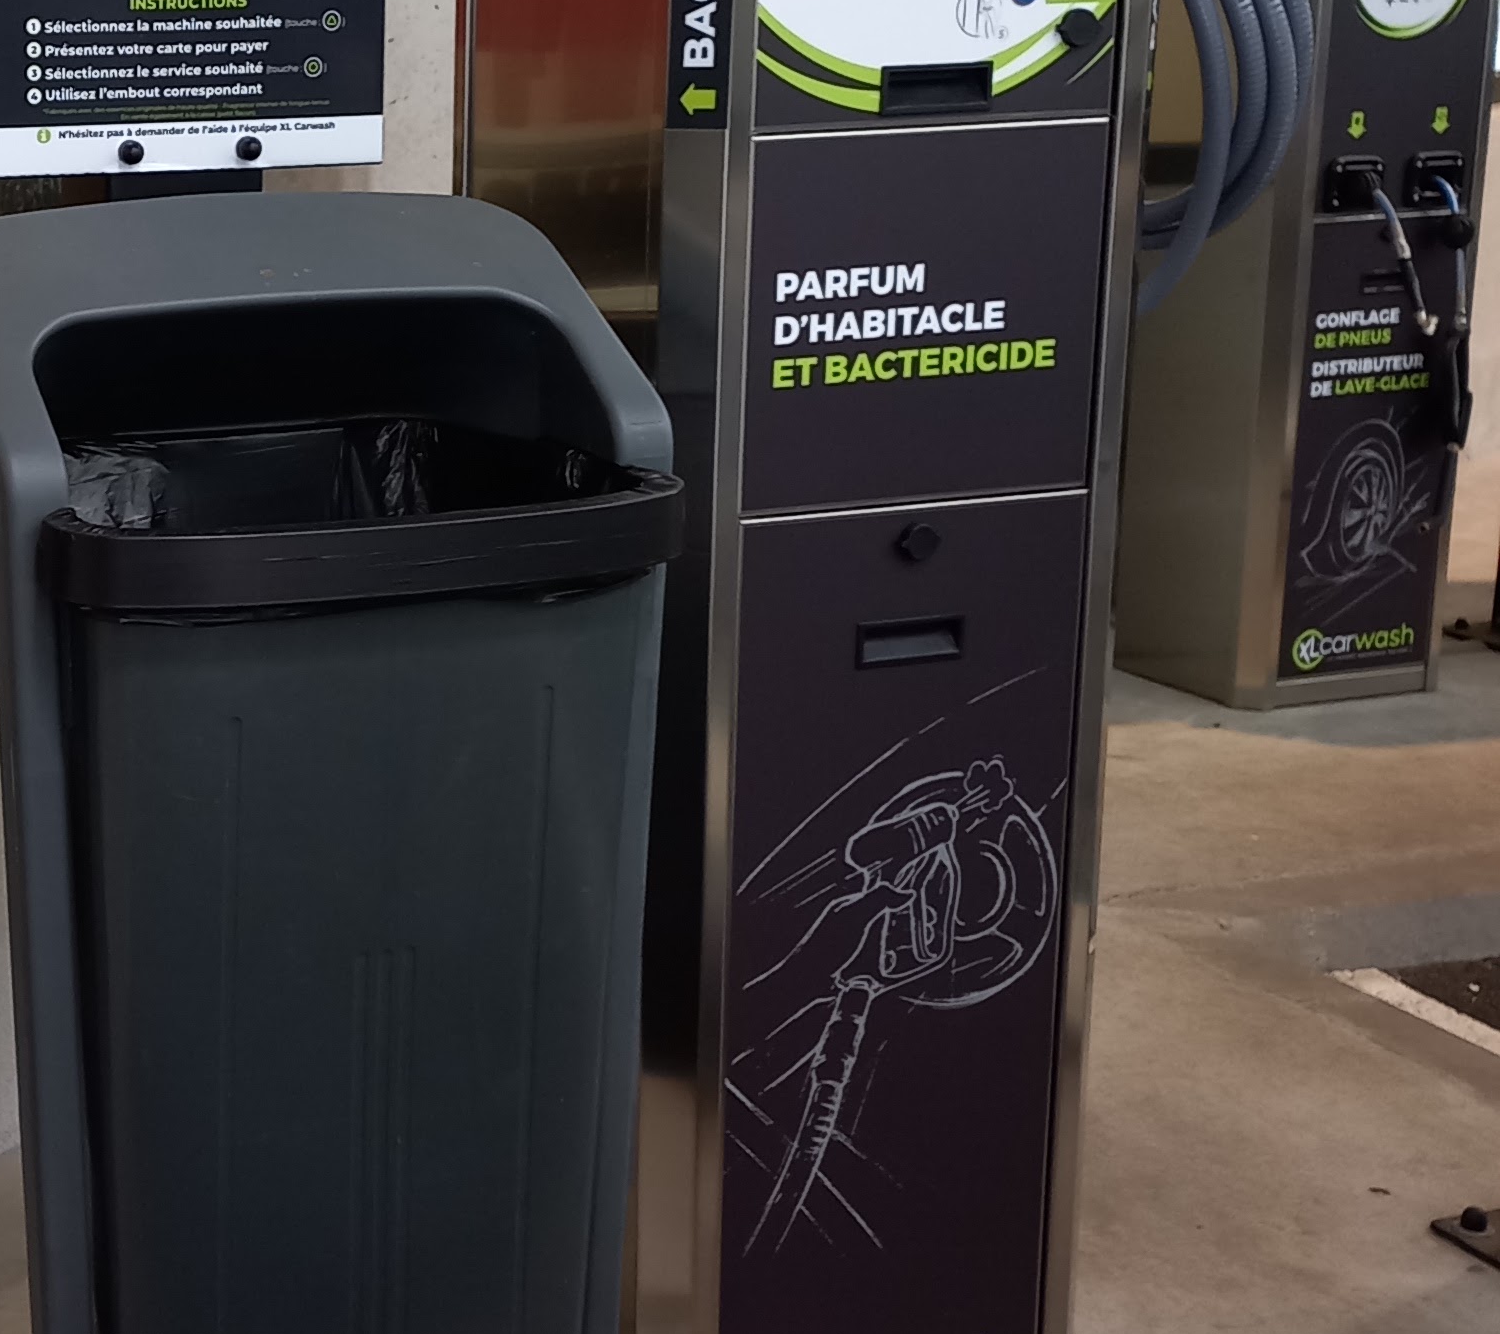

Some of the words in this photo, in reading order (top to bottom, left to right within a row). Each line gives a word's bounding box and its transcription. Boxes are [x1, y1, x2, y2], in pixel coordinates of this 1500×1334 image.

[44, 19, 135, 34] Sélectionnez
[136, 19, 150, 32] la
[152, 17, 212, 32] machine
[215, 15, 283, 30] souhaitée
[45, 43, 115, 57] Présentez
[117, 44, 154, 55] votre
[156, 43, 193, 54] carte
[195, 43, 228, 56] pour
[230, 41, 269, 55] payer
[44, 66, 135, 80] Sélectionnez
[137, 65, 150, 78] le
[152, 63, 202, 77] service
[204, 61, 264, 75] souhaité
[45, 87, 97, 102] Utilisez
[163, 83, 263, 99] correspondant
[106, 129, 124, 140] pas
[135, 127, 185, 137] demander
[188, 126, 200, 135] de
[280, 122, 292, 131] XL
[294, 122, 336, 131] Carwash
[776, 263, 926, 303] PARFUM
[1314, 333, 1336, 349] DE
[1338, 327, 1392, 347] PNEUS
[772, 356, 818, 389] ET
[824, 338, 1057, 385] BACTERICIDE
[1311, 353, 1424, 378] DISTRIBUTEUR
[1310, 380, 1332, 398] DE
[1334, 372, 1430, 396] LAVE-GLACE
